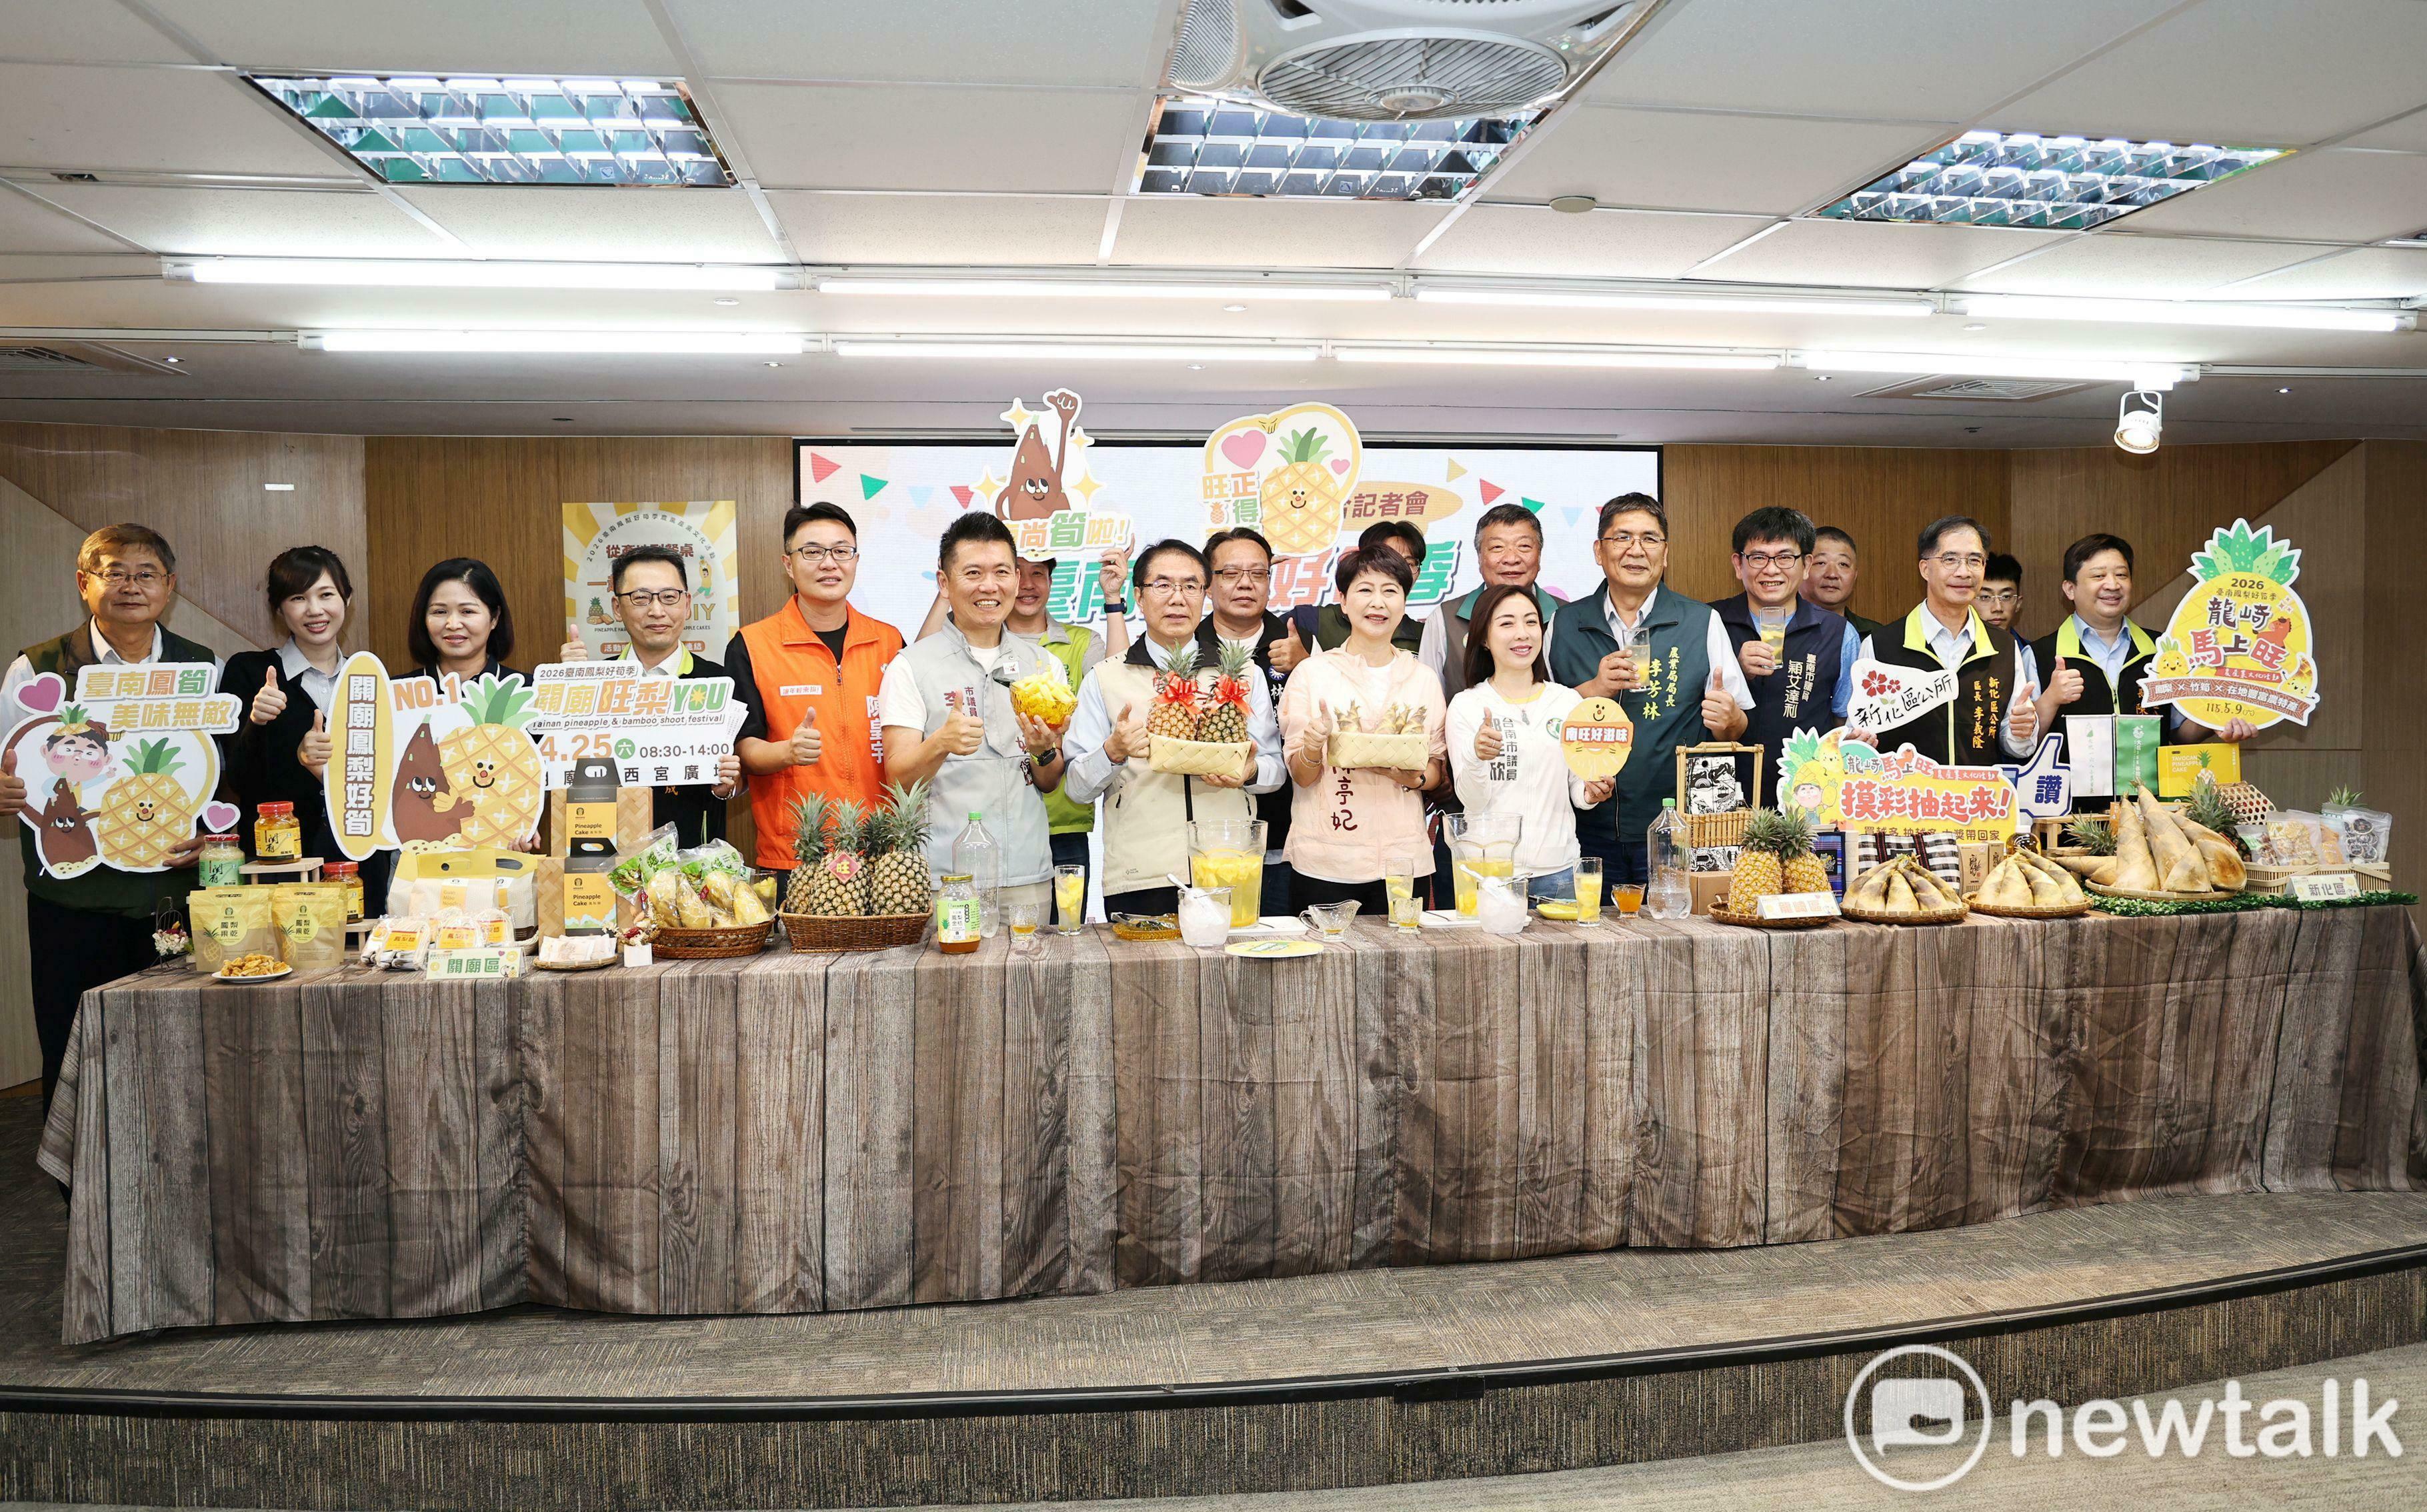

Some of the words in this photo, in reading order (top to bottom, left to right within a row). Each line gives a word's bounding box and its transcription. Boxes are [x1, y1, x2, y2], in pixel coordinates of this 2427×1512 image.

[1344, 491, 1429, 519] 記者會
[2231, 578, 2264, 589] 2026
[2208, 597, 2270, 629] 龍崎
[2189, 629, 2288, 669] 馬上旺
[83, 669, 207, 698] 臺南鳳筍
[540, 666, 635, 678] 2026臺南鳳梨好筍季
[1666, 646, 1680, 707] 農業局局長
[1802, 653, 1817, 702] 臺南市議員
[2190, 681, 2211, 693] 竹筍
[393, 677, 459, 711] NO.1
[1642, 659, 1663, 721] 李芳林
[1782, 659, 1804, 719] 穎艾達利
[1854, 673, 1952, 727] 新化區公所
[1974, 681, 1983, 702] 區長
[111, 701, 233, 729] 美味無敵
[564, 718, 608, 729] pineapple
[622, 716, 657, 725] bamboo
[660, 715, 685, 724] shoot
[688, 713, 723, 723] festival
[1988, 676, 2000, 739] 新化區公所
[1972, 705, 1985, 749] 李義隆
[346, 675, 377, 835] 關廟鳳梨好筍
[539, 734, 612, 762] 4.25
[640, 743, 729, 759] 08:30-14:00
[1502, 717, 1518, 781] 台南市議員
[1331, 767, 1358, 831] 亭妃
[1842, 781, 2010, 823] 摸彩抽起來!
[2035, 775, 2062, 804] 讚
[2308, 883, 2346, 896] 新化區
[447, 957, 500, 974] 關廟區
